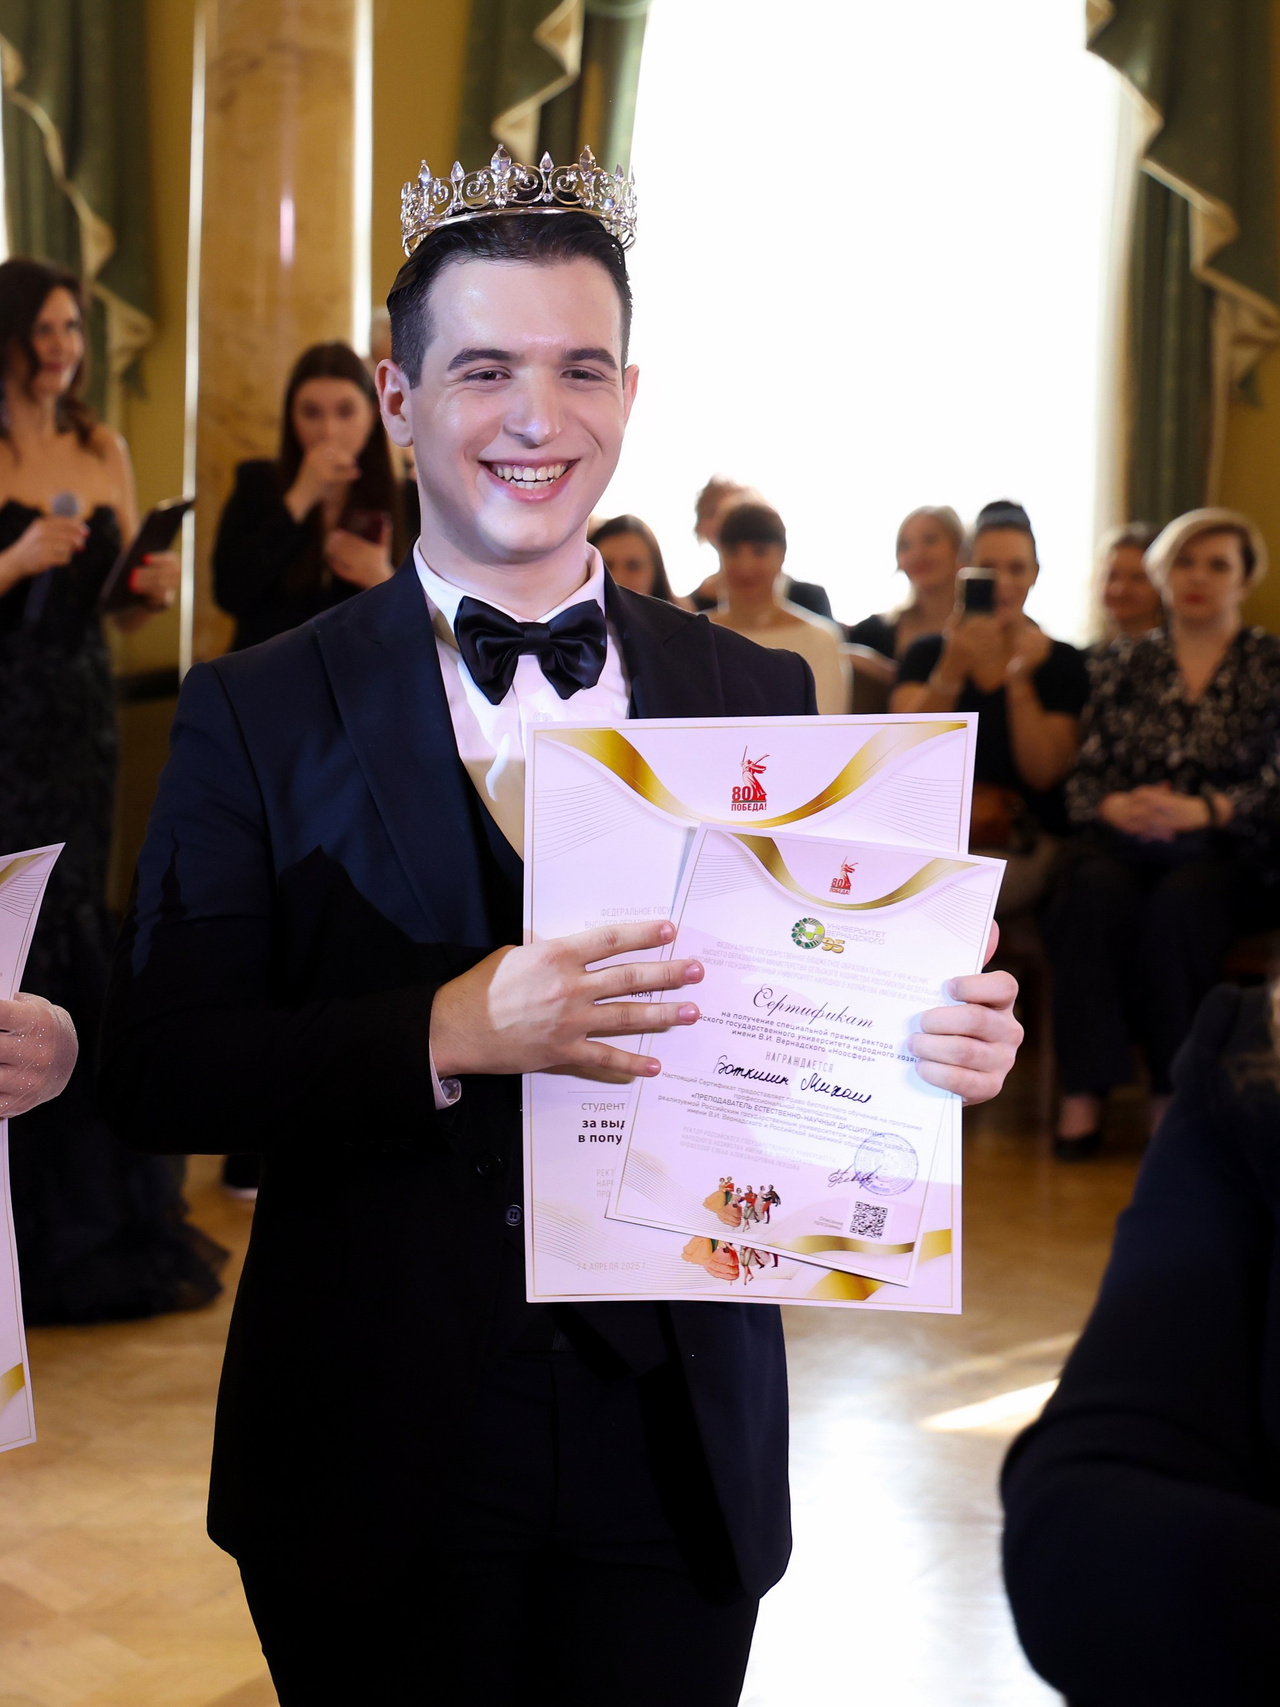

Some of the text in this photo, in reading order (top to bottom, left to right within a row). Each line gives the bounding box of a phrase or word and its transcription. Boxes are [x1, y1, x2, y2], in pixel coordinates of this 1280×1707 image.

[732, 786, 751, 801] 80
[731, 803, 767, 812] ПОБЕДА!
[826, 930, 885, 945] ВЕРНАДСКОГО
[827, 922, 887, 938] УНИВЕРСИТЕТ
[753, 983, 874, 1029] Сертификат
[726, 1019, 794, 1040] государственного
[796, 1032, 850, 1050] университета
[852, 1044, 894, 1058] народного
[732, 1013, 774, 1027] получение
[776, 1020, 828, 1037] специальной
[830, 1031, 860, 1043] премии
[862, 1037, 894, 1050] ректора
[732, 1028, 876, 1062] имени В.И. Вернадского «Ноосфера»
[764, 1049, 834, 1074] НАГРАЖДАЕТСЯ
[698, 1078, 736, 1092] Сертификат
[738, 1087, 784, 1101] предоставляет
[581, 1102, 626, 1112] студент
[690, 1091, 752, 1109] «ПРЕПОДАВАТЕЛЬ
[754, 1104, 836, 1126] ЕСТЕСТВЕННО-НАУЧНЫХ
[582, 1120, 597, 1128] за
